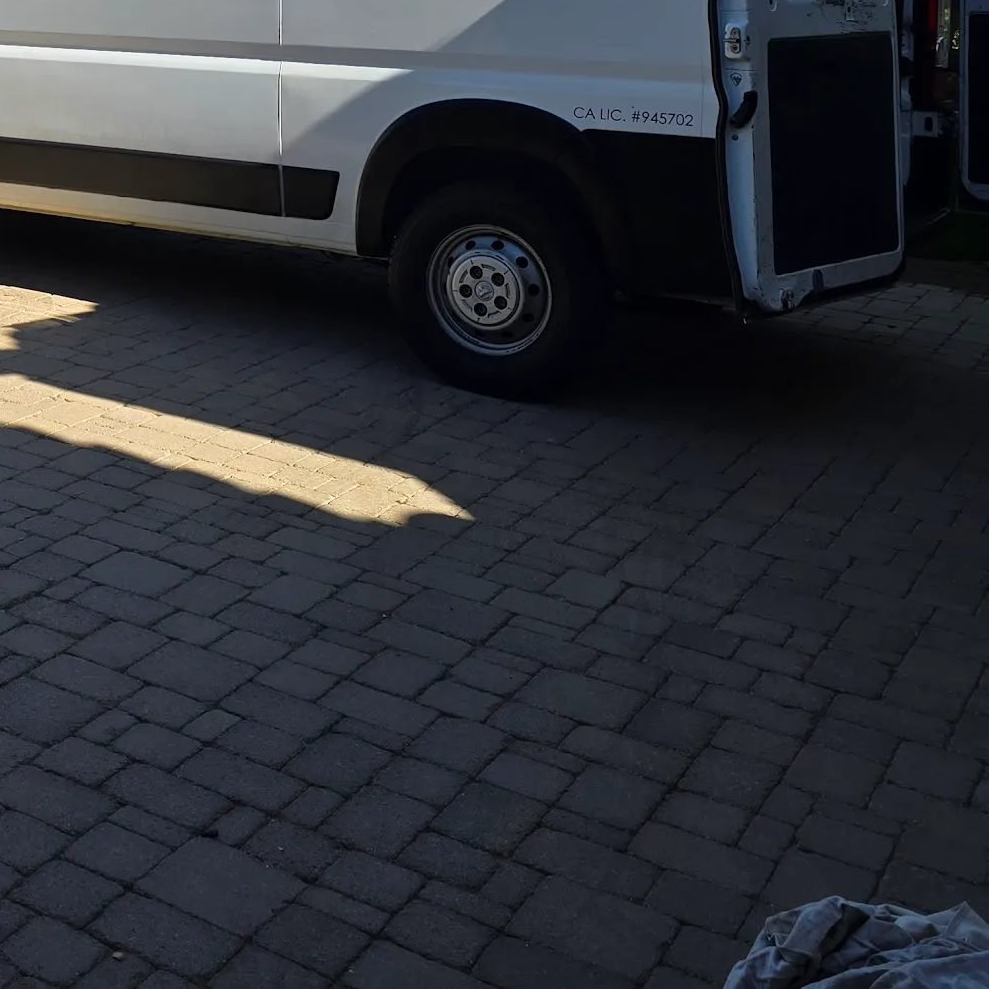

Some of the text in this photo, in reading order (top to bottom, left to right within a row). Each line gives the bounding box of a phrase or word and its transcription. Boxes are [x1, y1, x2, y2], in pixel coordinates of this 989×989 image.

[573, 106, 694, 127] CA LIC. #945702
